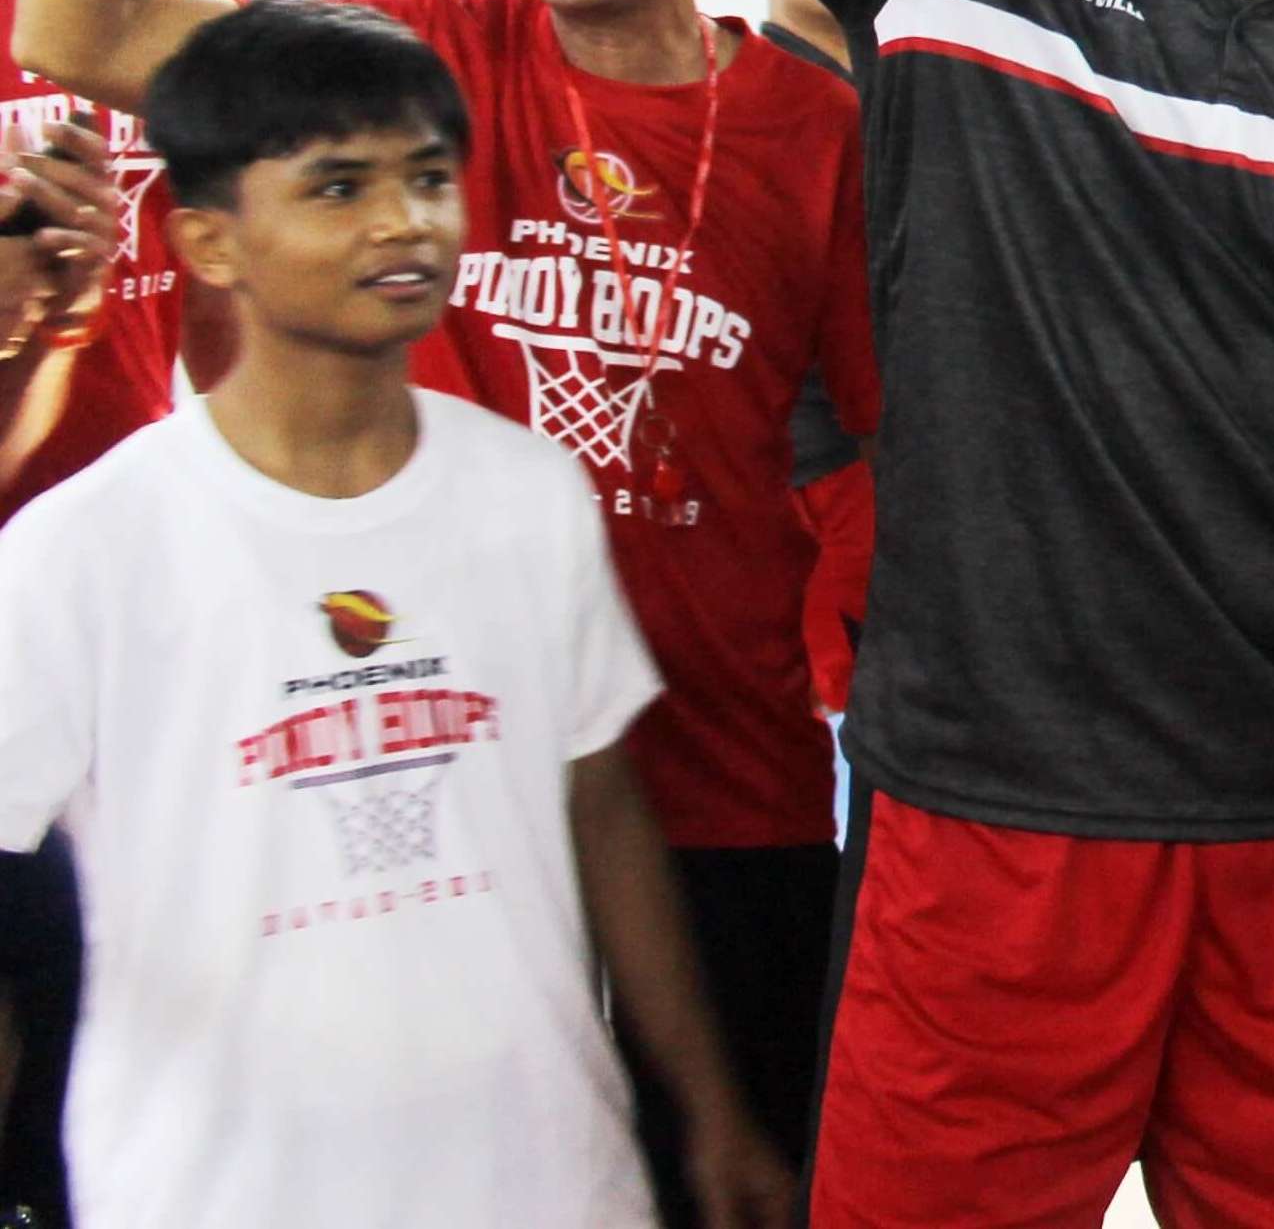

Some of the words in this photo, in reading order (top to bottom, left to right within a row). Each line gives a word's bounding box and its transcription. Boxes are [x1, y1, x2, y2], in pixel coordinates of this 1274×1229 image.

[448, 250, 583, 329] PINOY
[591, 269, 752, 370] HOOPS
[284, 656, 450, 699] PHOENIX
[235, 698, 365, 787] PINOY
[375, 688, 500, 755] HOOPS
